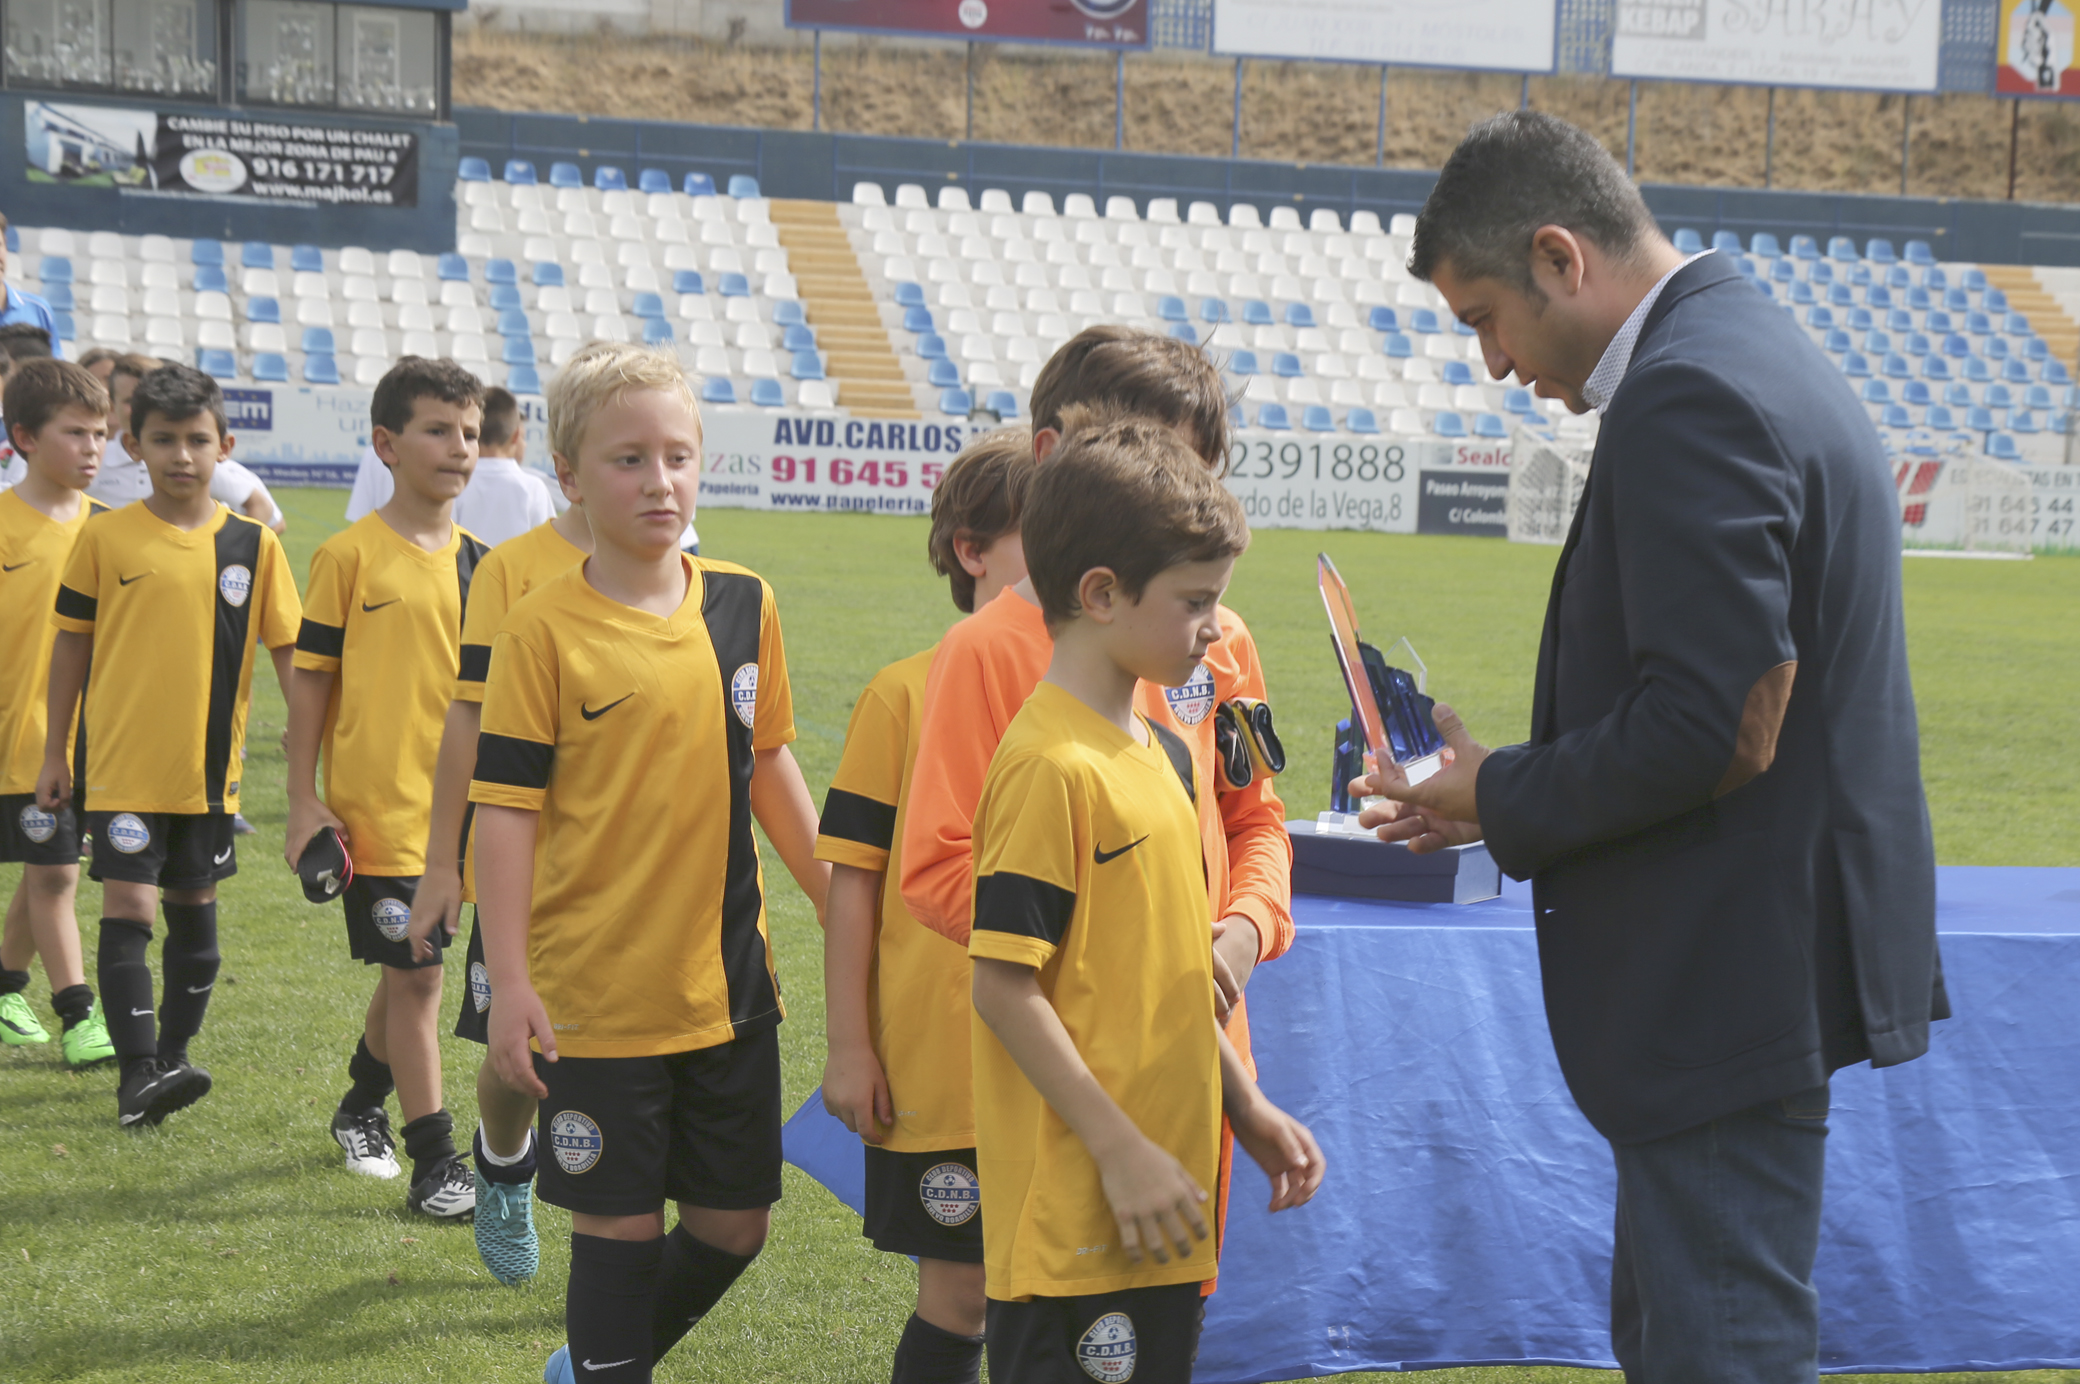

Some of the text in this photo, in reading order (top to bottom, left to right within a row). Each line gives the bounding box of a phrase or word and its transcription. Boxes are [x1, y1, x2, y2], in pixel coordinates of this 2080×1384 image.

[1618, 6, 1700, 37] KEBAP
[167, 116, 411, 149] CAMBIE SU PISO POR UN CHALET
[182, 134, 205, 149] EN
[207, 136, 228, 150] LA
[230, 137, 283, 155] MEJOR
[286, 142, 329, 160] ZONA
[331, 146, 352, 161] DE
[353, 148, 385, 164] PAU
[252, 157, 299, 179] 916
[302, 160, 345, 182] 171
[351, 164, 396, 186] 717
[252, 181, 394, 204] www.majhol.es
[771, 455, 816, 483] 91
[829, 458, 909, 488] 645
[1426, 479, 1460, 497] Paseo
[1277, 488, 1304, 519] de
[1310, 489, 1327, 519] la
[1171, 685, 1211, 701] C.D.N.B.
[563, 1112, 596, 1132] DEPORTIVO
[554, 1135, 596, 1149] C.D.N.B.
[925, 1164, 974, 1183] CLUB DEPORTIVO
[926, 1187, 975, 1200] C.D.N.B.
[925, 1202, 976, 1224] NUEVO BOADILLA
[1088, 1320, 1105, 1339] CLUB
[1085, 1342, 1134, 1357] C.D.N.B.
